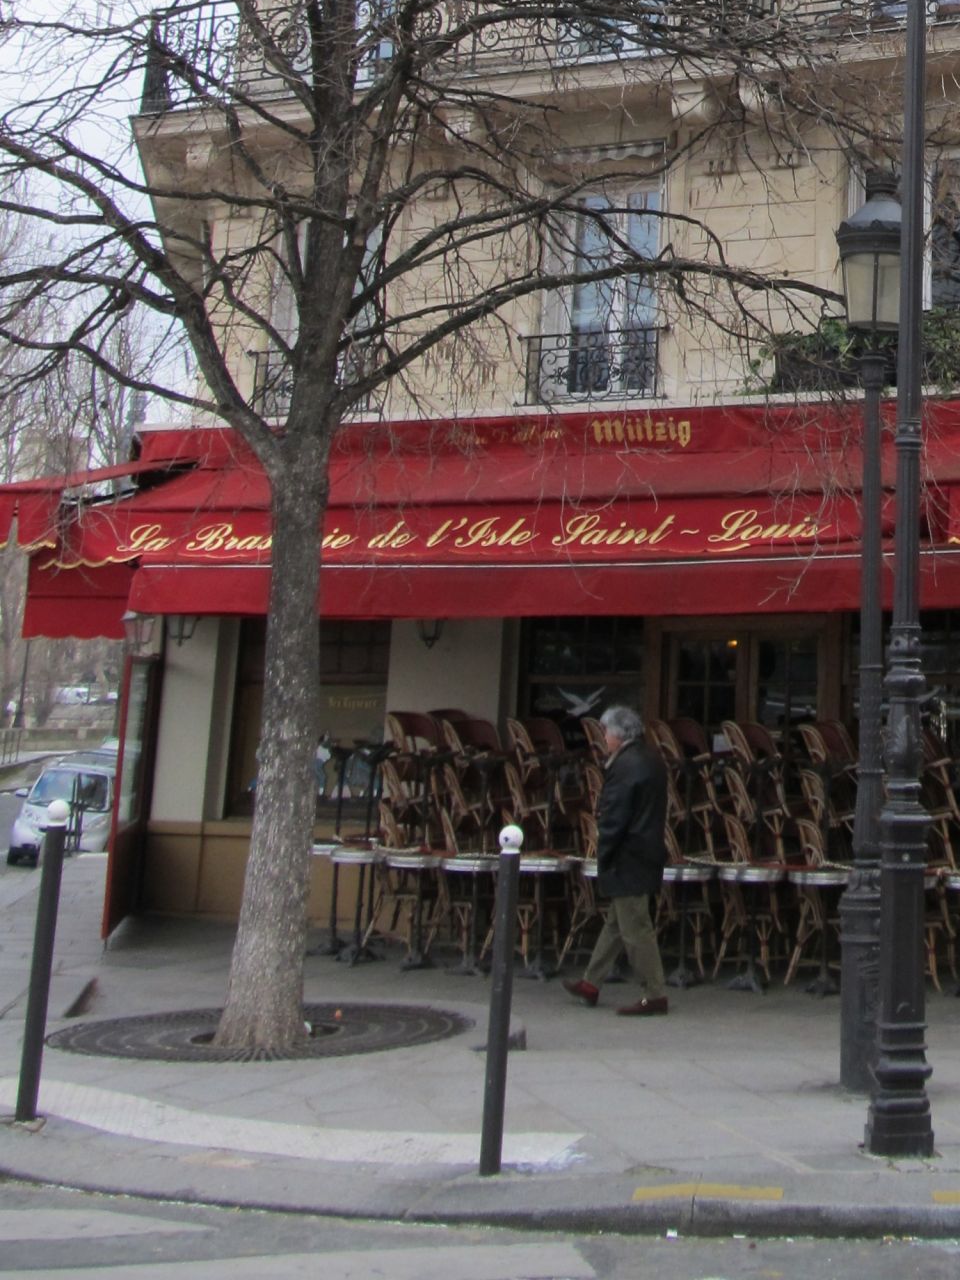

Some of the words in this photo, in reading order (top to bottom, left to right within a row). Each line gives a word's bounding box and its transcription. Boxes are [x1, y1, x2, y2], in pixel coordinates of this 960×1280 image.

[116, 524, 176, 552] La
[186, 522, 359, 551] Brasie
[368, 520, 419, 549] de
[425, 516, 540, 548] l'Isle
[551, 514, 676, 546] Saint
[707, 509, 832, 543] Louis
